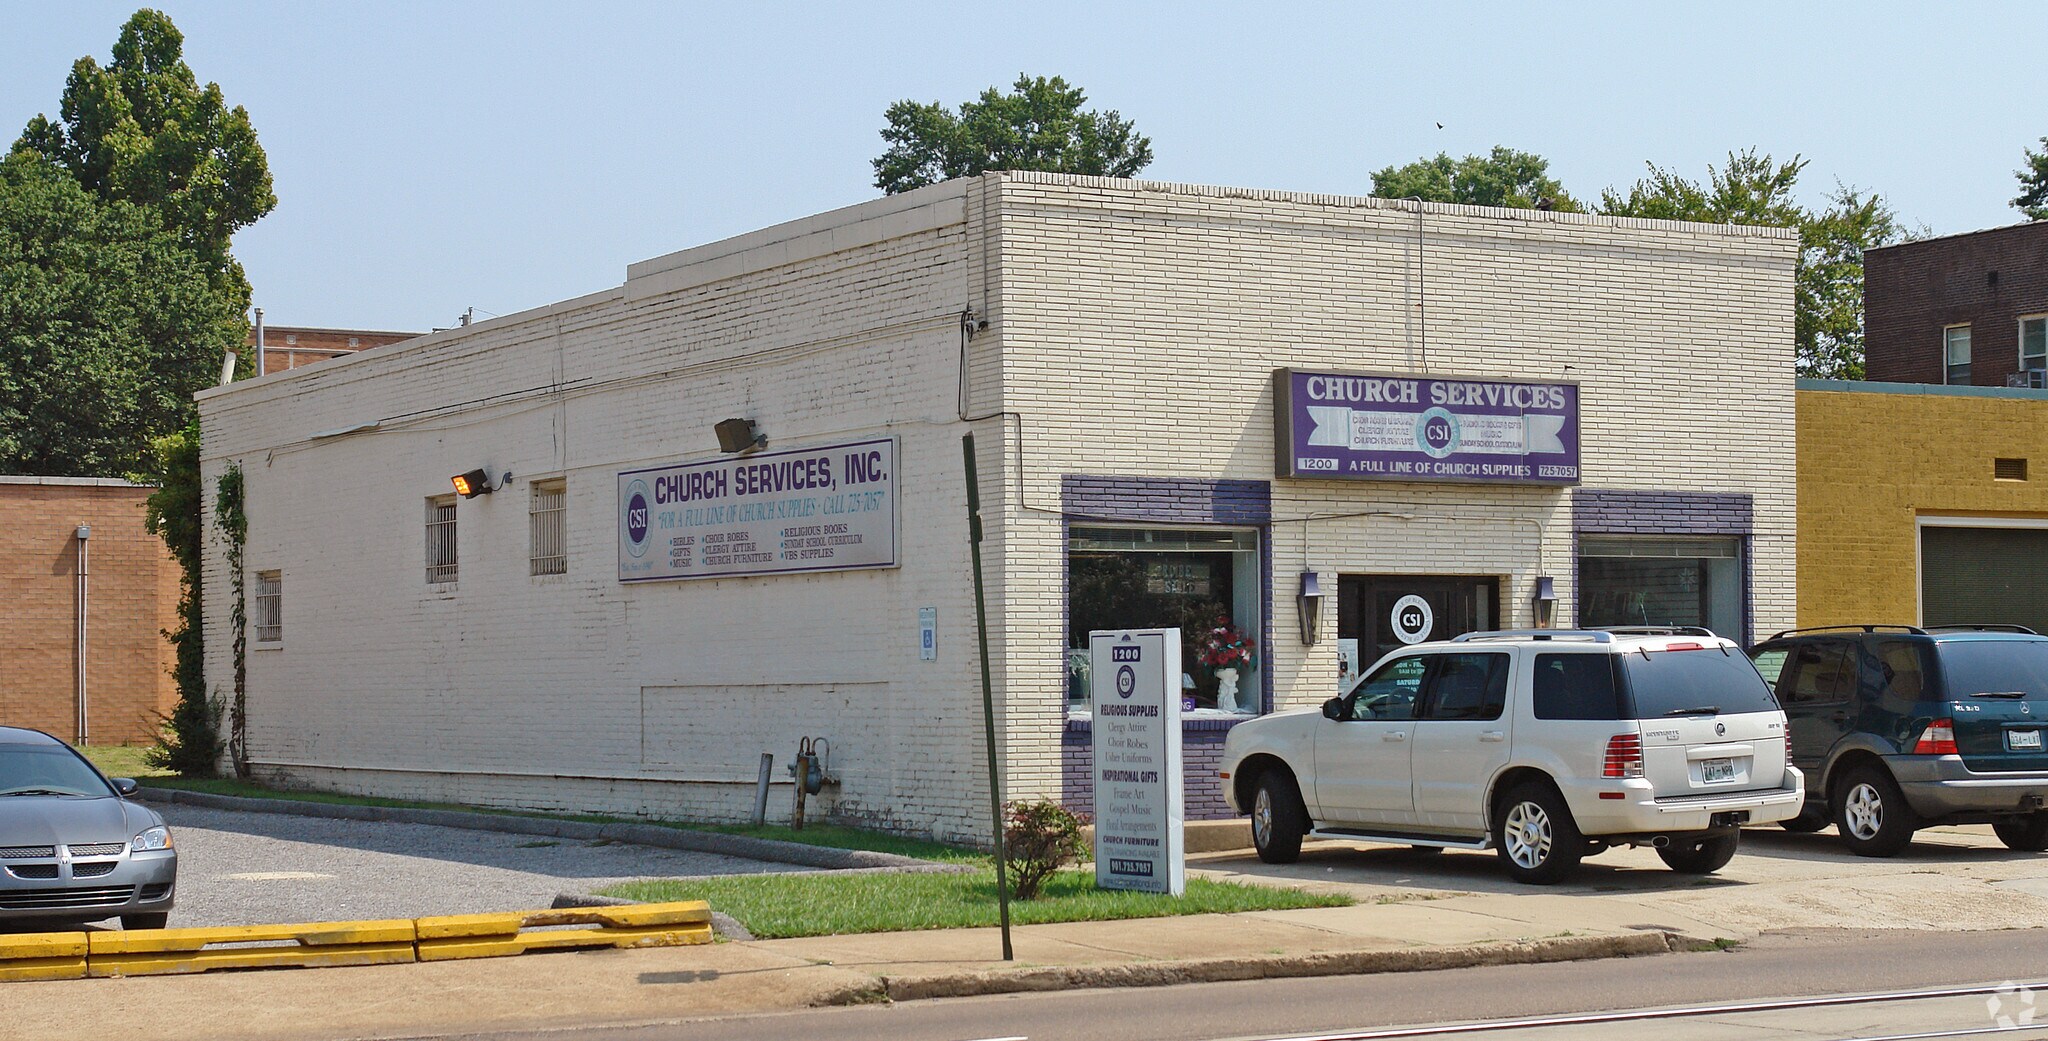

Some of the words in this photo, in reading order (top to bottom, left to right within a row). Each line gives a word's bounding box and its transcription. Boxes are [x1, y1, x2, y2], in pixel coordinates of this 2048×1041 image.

[1306, 376, 1419, 403] CHURCH
[1430, 382, 1566, 409] SERVICES
[1427, 425, 1449, 440] CSI
[1304, 459, 1332, 469] 1200
[1349, 460, 1357, 471] A
[1361, 461, 1385, 472] FULL
[1390, 461, 1412, 473] LINE
[1415, 462, 1431, 474] OF
[1434, 462, 1479, 475] CHURCH
[1482, 464, 1531, 476] SUPPLIES
[655, 469, 727, 504] CHURCH
[735, 457, 836, 495] SERVICES,
[845, 451, 887, 485] INC.
[678, 511, 683, 527] A
[685, 508, 703, 526] FULL
[706, 505, 725, 525] LINE
[726, 504, 737, 523] OF
[739, 501, 775, 522] CHURCH
[777, 497, 816, 519] SUPPLIES
[823, 494, 845, 515] CALL
[629, 508, 647, 529] CSI
[784, 525, 821, 538] RELIGIOUS
[823, 523, 848, 536] BOOKS
[673, 536, 695, 547] BIBLES
[705, 533, 725, 544] CHOIR
[727, 531, 749, 542] ROBES
[784, 538, 805, 549] SUNDAY
[806, 536, 827, 548] SCHOOL
[828, 534, 863, 545] CURRICULUM
[673, 547, 691, 557] GIFTS
[705, 544, 729, 556] CLERGY
[732, 542, 757, 553] ATTIRE
[784, 549, 798, 560] VBS
[800, 547, 834, 560] SUPPLIES
[673, 558, 692, 568] MUSIC
[705, 555, 731, 566] CHURCH
[733, 552, 773, 564] FURNITURE
[1403, 613, 1420, 626] CSI
[1114, 649, 1138, 660] 1200
[1121, 678, 1129, 687] CSI
[1101, 704, 1127, 716] RELIGIOUS
[1129, 705, 1158, 717] SUPPLIES
[1108, 723, 1126, 733] Clergy
[1127, 723, 1147, 732] Attire
[1108, 737, 1125, 746] Choir
[1127, 738, 1148, 749] Robes
[1122, 752, 1152, 763] Uniforms
[1102, 769, 1138, 782] INSPIRATIONAL
[1140, 771, 1158, 783] GIFTS
[1113, 788, 1133, 799] Frame
[1135, 789, 1145, 799] Art
[1109, 803, 1130, 815] Gospel
[1131, 804, 1152, 815] Music
[1103, 835, 1123, 845] CHURCH
[1124, 837, 1159, 847] FURNITURE
